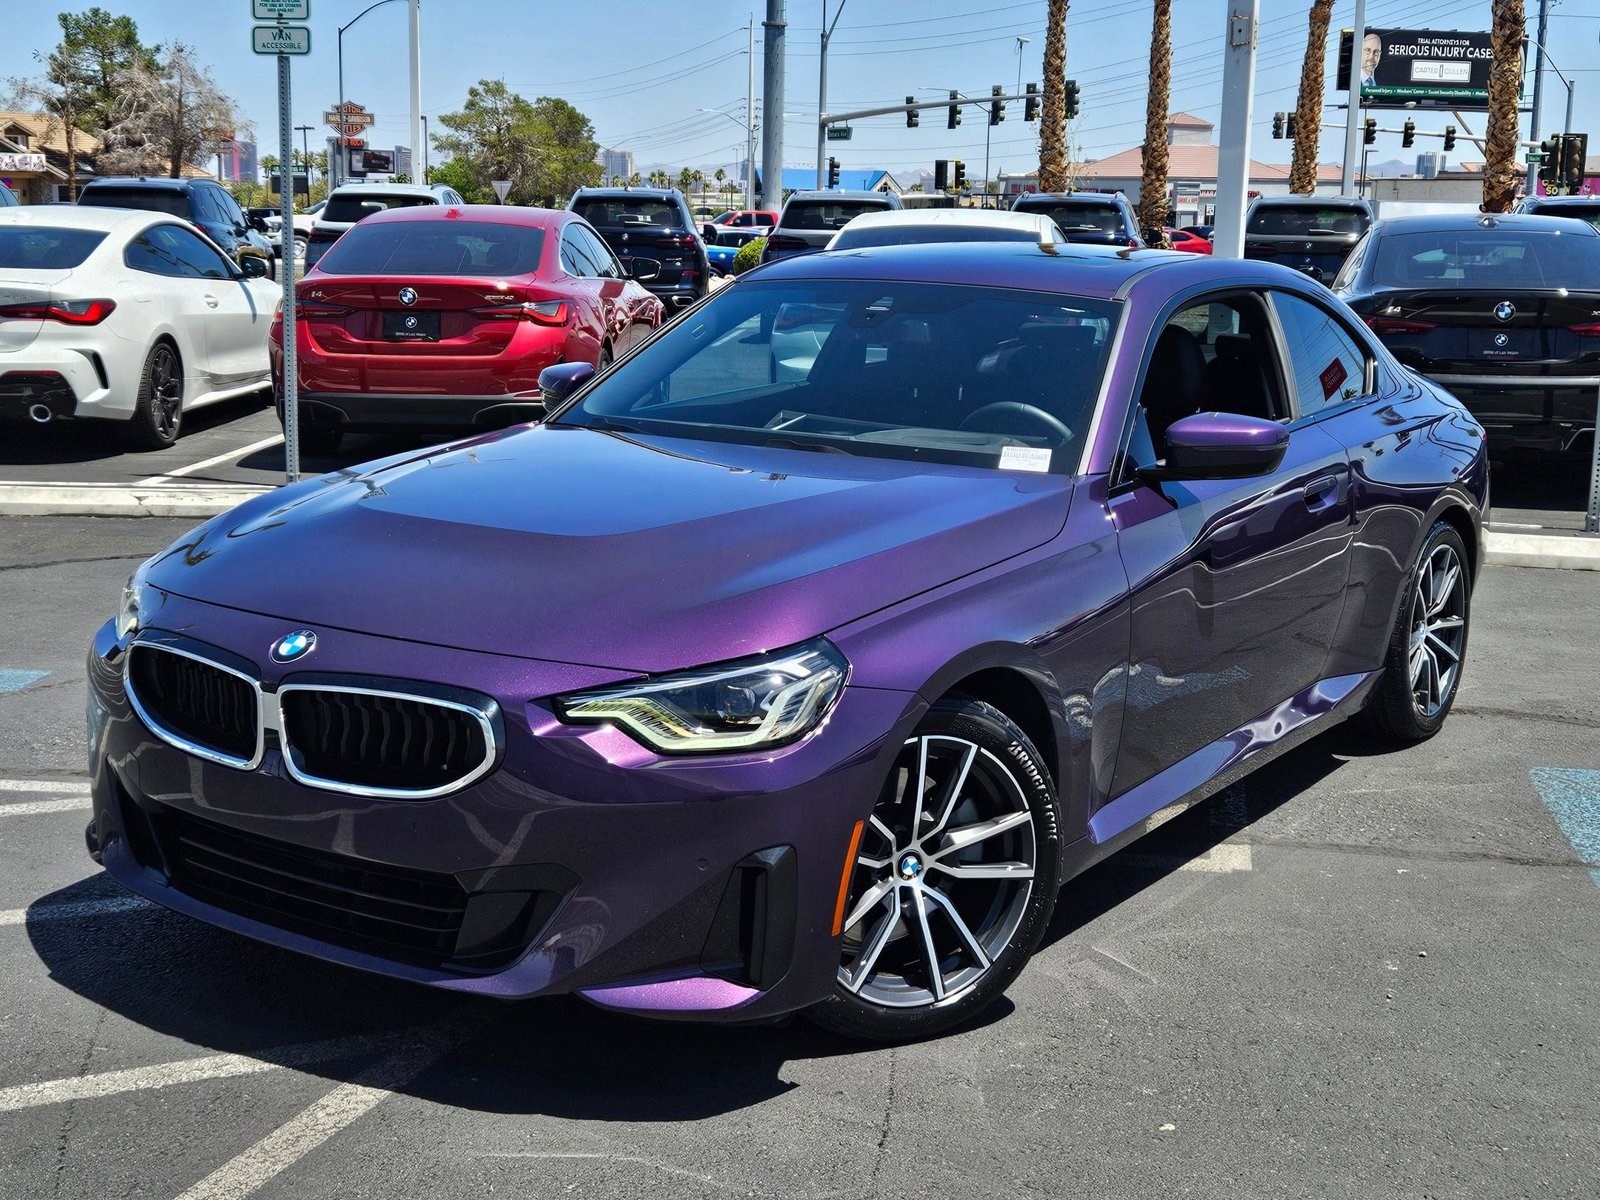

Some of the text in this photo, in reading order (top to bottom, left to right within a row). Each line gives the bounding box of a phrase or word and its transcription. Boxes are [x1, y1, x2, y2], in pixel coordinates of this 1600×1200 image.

[271, 31, 291, 41] VAN
[1431, 38, 1459, 46] ATTORNEYS
[1388, 44, 1430, 56] SERIOUS
[1431, 45, 1466, 58] INJURY
